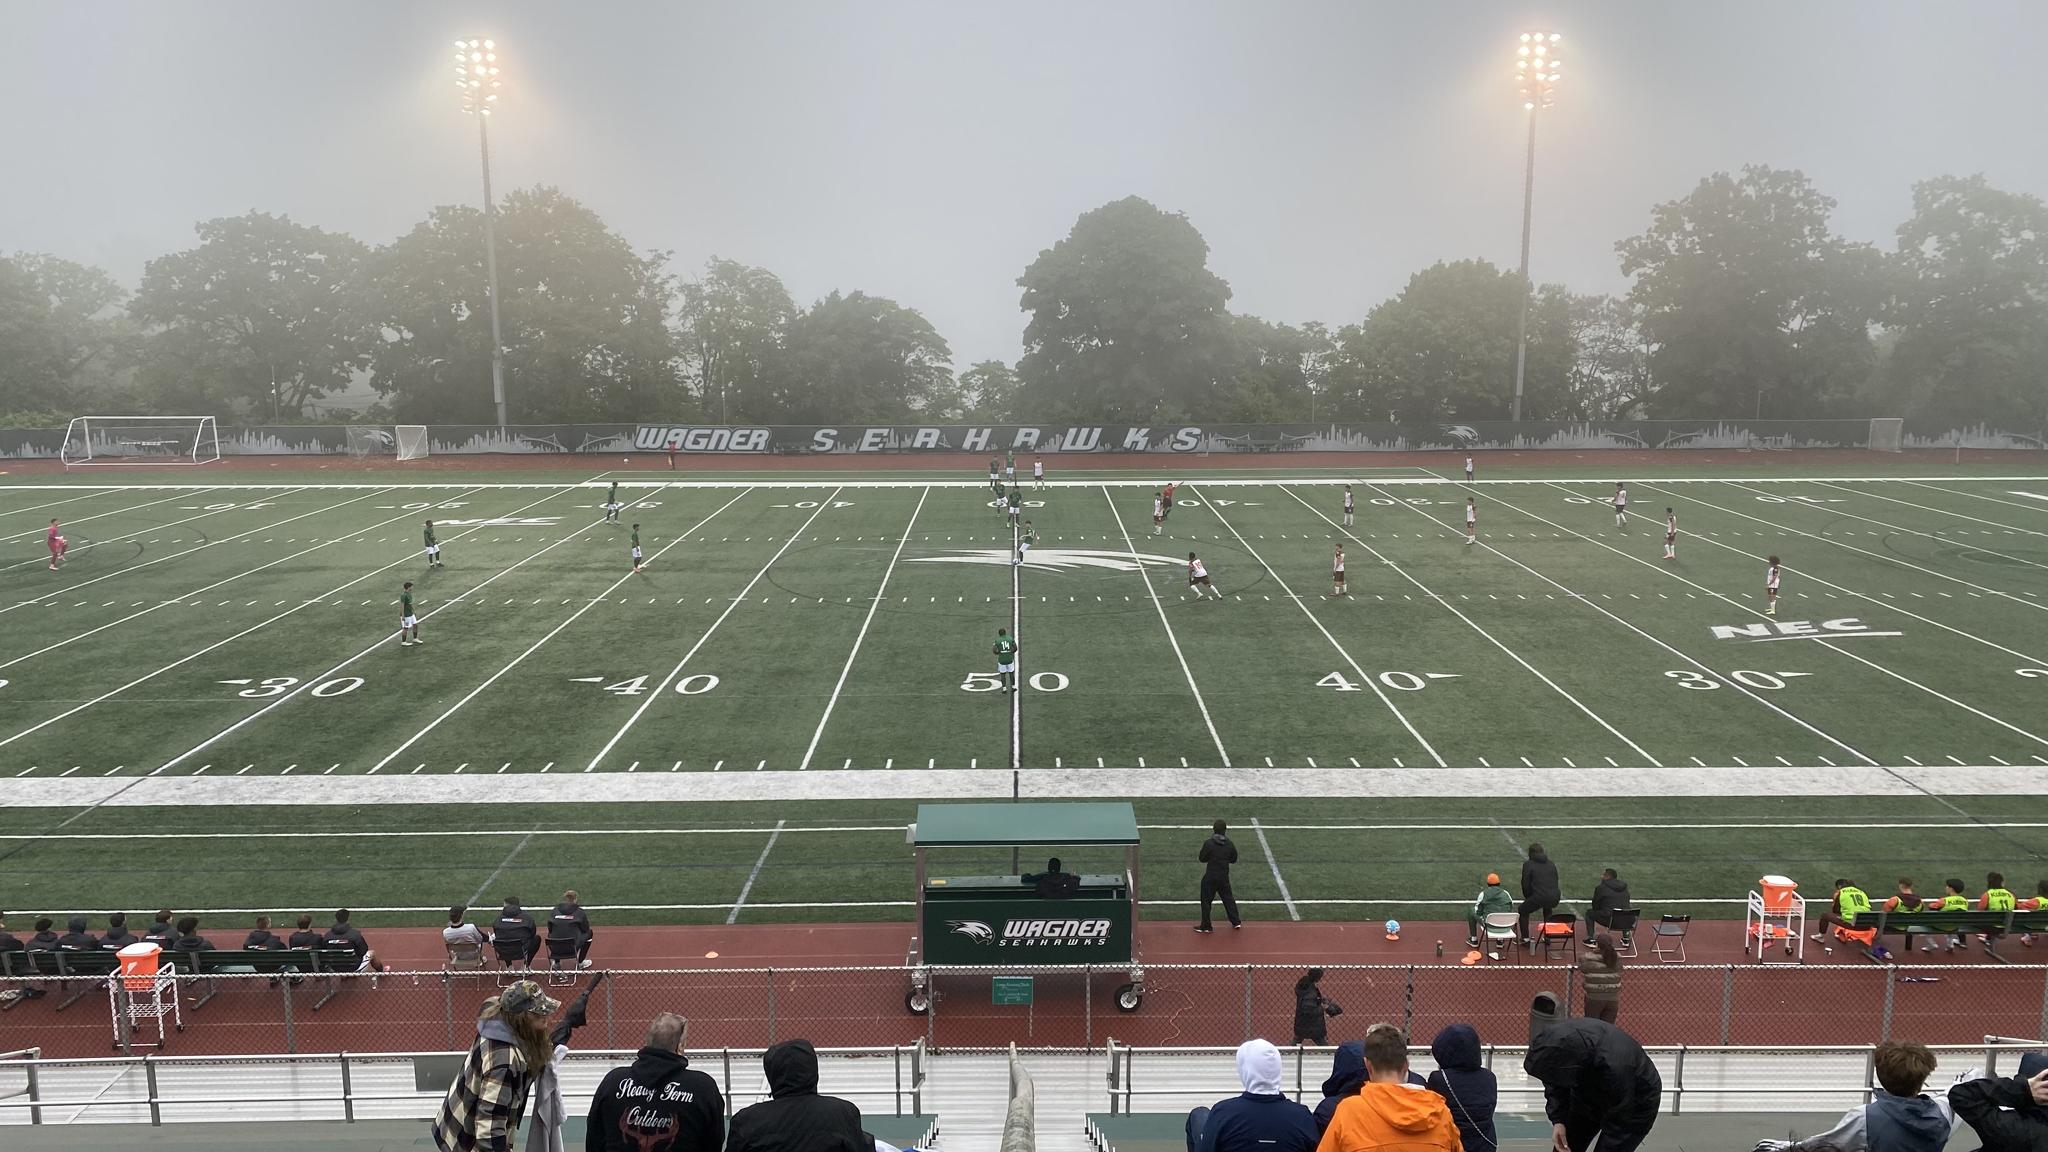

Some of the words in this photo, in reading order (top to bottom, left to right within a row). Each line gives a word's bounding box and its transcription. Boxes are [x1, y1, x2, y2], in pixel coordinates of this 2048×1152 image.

[635, 427, 771, 451] WAGNER
[1711, 618, 1868, 640] NEC
[1001, 640, 1010, 650] 14
[237, 677, 365, 698] 30
[603, 674, 720, 695] 40
[960, 672, 1070, 692] 50
[1315, 671, 1427, 691] 40
[1664, 670, 1787, 690] 30
[1003, 919, 1112, 938] WAGNER
[999, 938, 1106, 947] SEAHAWKS
[626, 1105, 674, 1128] Outdoors
